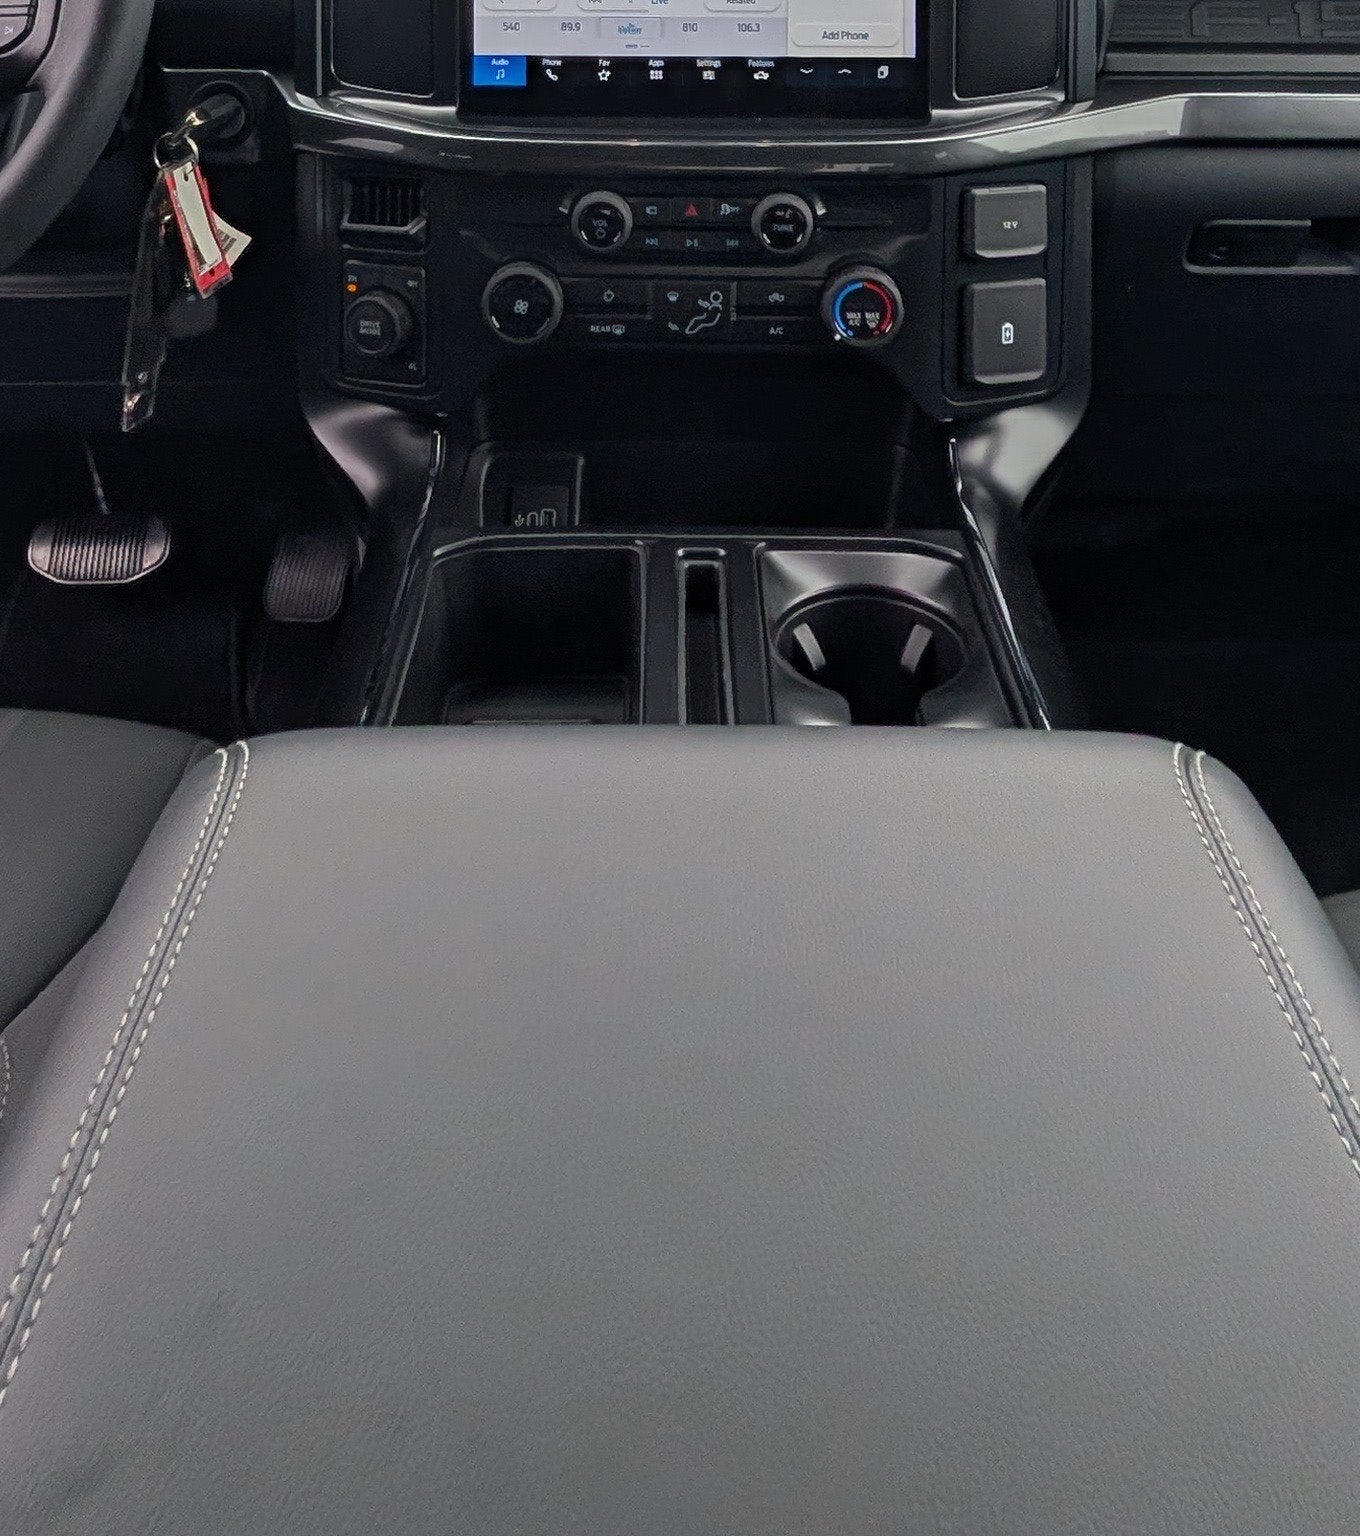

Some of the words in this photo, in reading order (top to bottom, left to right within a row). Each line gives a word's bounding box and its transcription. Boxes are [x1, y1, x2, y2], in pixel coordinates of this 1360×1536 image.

[502, 22, 520, 32] 540
[561, 22, 581, 32] 89.9
[682, 22, 698, 32] 810
[737, 22, 760, 33] 106.3
[822, 30, 840, 40] Add
[841, 30, 869, 41] Phone
[491, 58, 509, 66] Audio
[542, 58, 561, 67] Phone
[648, 59, 664, 68] Apps
[696, 59, 721, 68] Settings
[748, 59, 775, 68] Features
[590, 324, 611, 333] REAR
[769, 327, 784, 335] A/C
